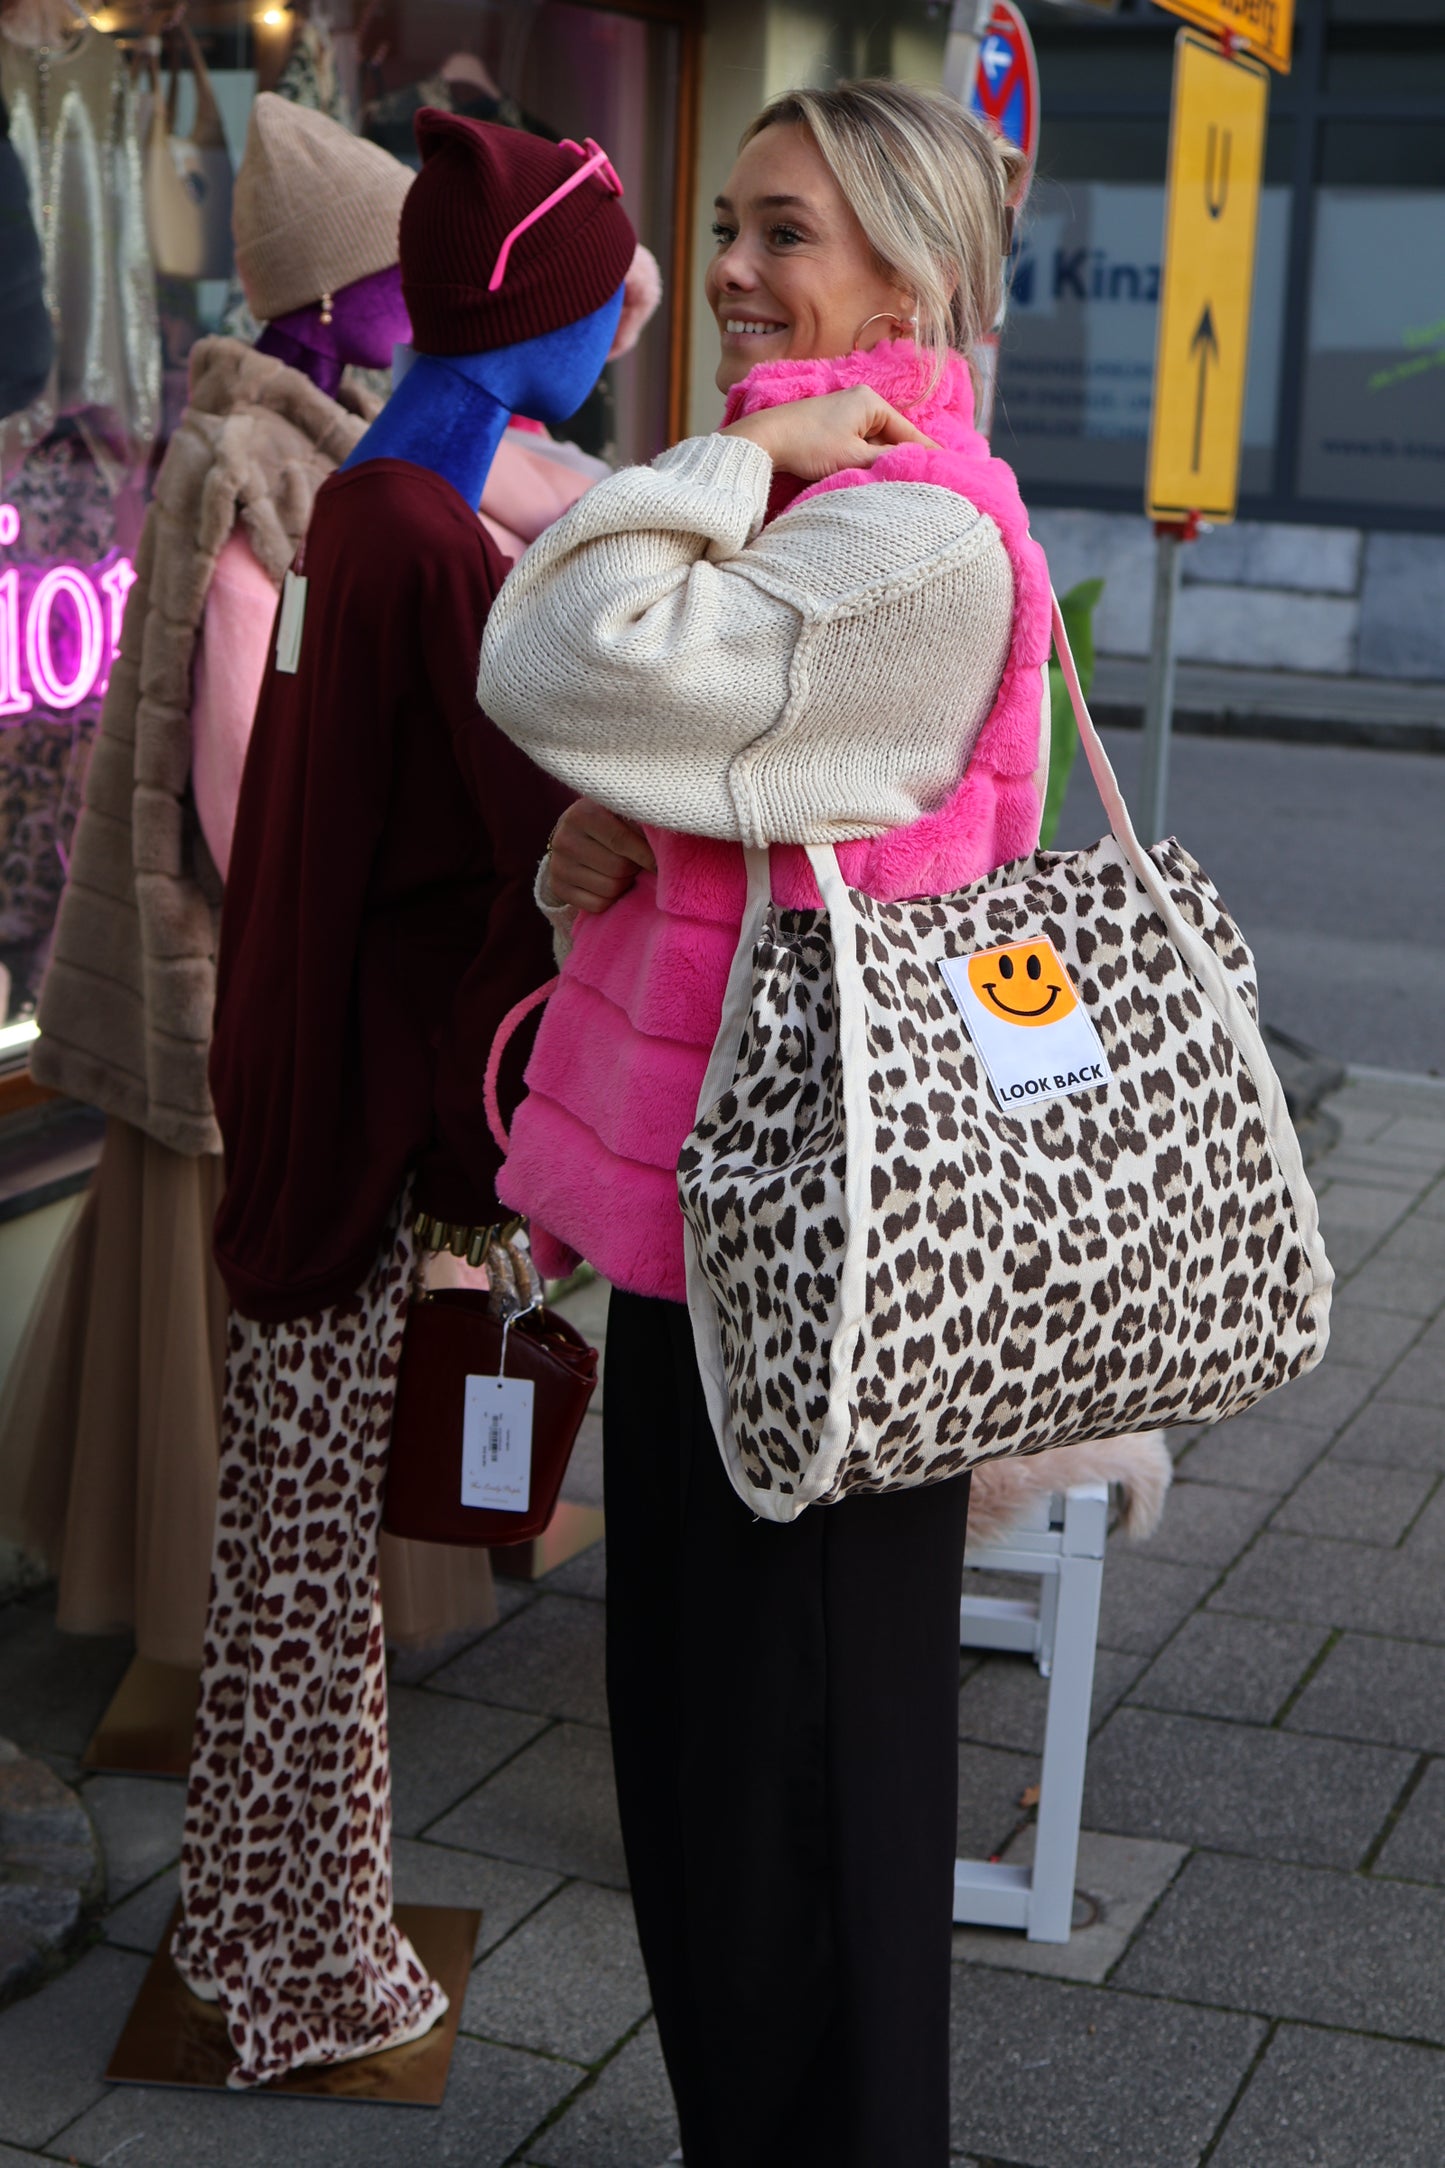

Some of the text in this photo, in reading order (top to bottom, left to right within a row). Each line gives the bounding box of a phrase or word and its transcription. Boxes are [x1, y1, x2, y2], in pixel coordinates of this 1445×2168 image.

[1204, 123, 1234, 220] U
[1000, 1063, 1104, 1102] LOOK BACK
